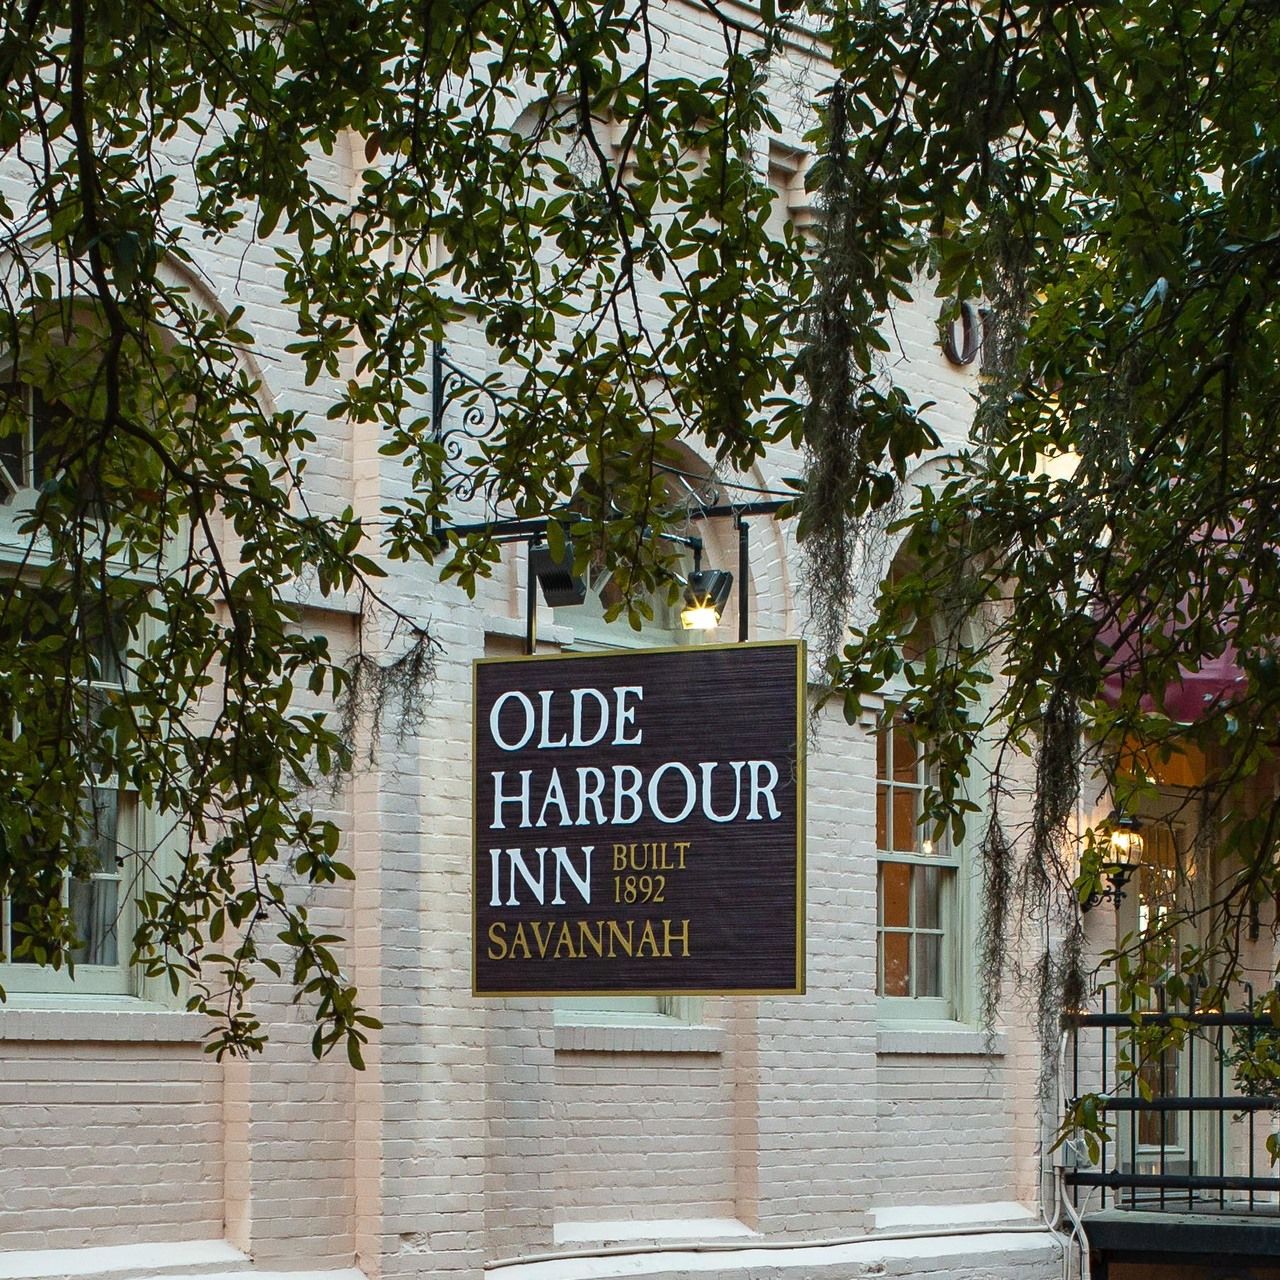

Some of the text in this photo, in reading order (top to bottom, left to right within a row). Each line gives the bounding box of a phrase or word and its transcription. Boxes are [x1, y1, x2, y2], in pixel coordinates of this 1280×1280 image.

[489, 686, 643, 751] OLDE
[489, 760, 782, 829] HARBOUR
[489, 846, 595, 906] INN
[612, 842, 691, 871] BUILT
[614, 875, 666, 904] 1892
[488, 919, 691, 960] SAVANNAH
